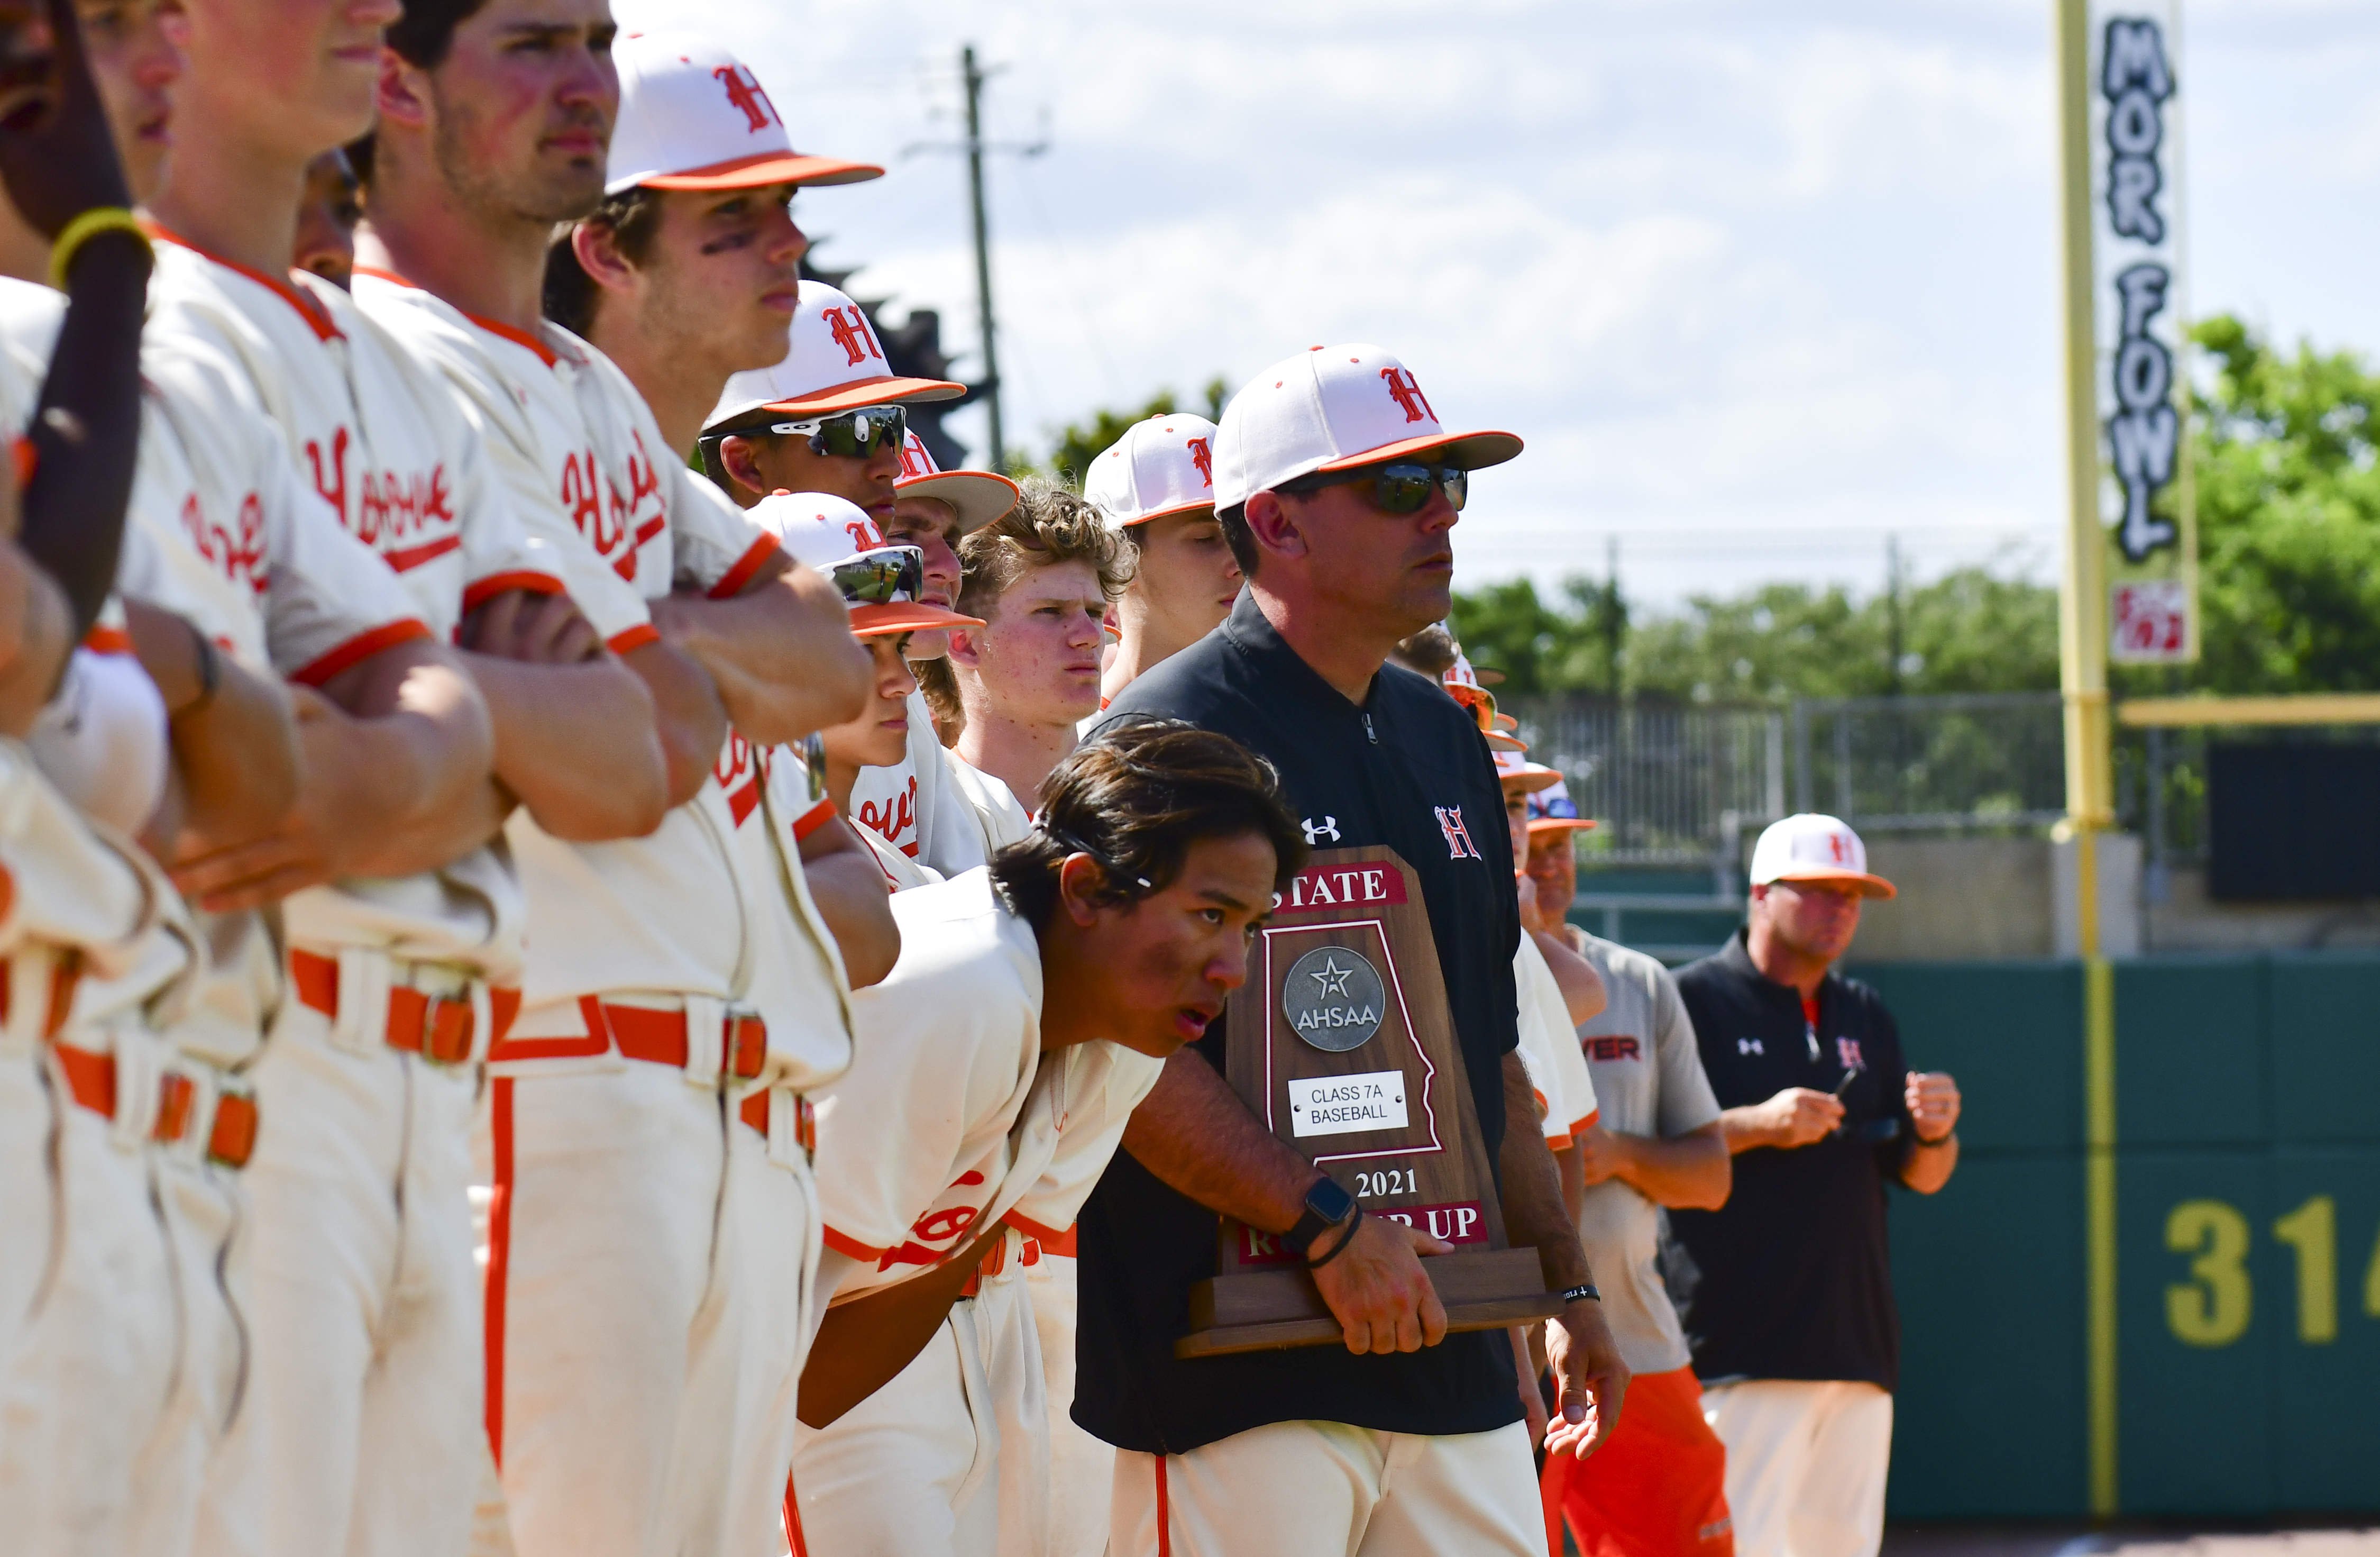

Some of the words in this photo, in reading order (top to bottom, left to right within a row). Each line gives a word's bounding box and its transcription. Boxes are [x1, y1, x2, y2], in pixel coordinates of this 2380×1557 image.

[712, 64, 784, 133] H
[2103, 16, 2175, 245] MOR
[821, 305, 882, 367] H
[1379, 367, 1439, 424] H
[2112, 266, 2177, 562] FOWL
[1434, 804, 1482, 861] H
[1297, 1004, 1378, 1030] AHSAA
[1311, 1104, 1388, 1124] BASEBALL
[1312, 1086, 1360, 1104] CLASS
[1364, 1084, 1383, 1099] 7A
[1355, 1168, 1418, 1198] 2021
[1425, 1207, 1477, 1240] UP
